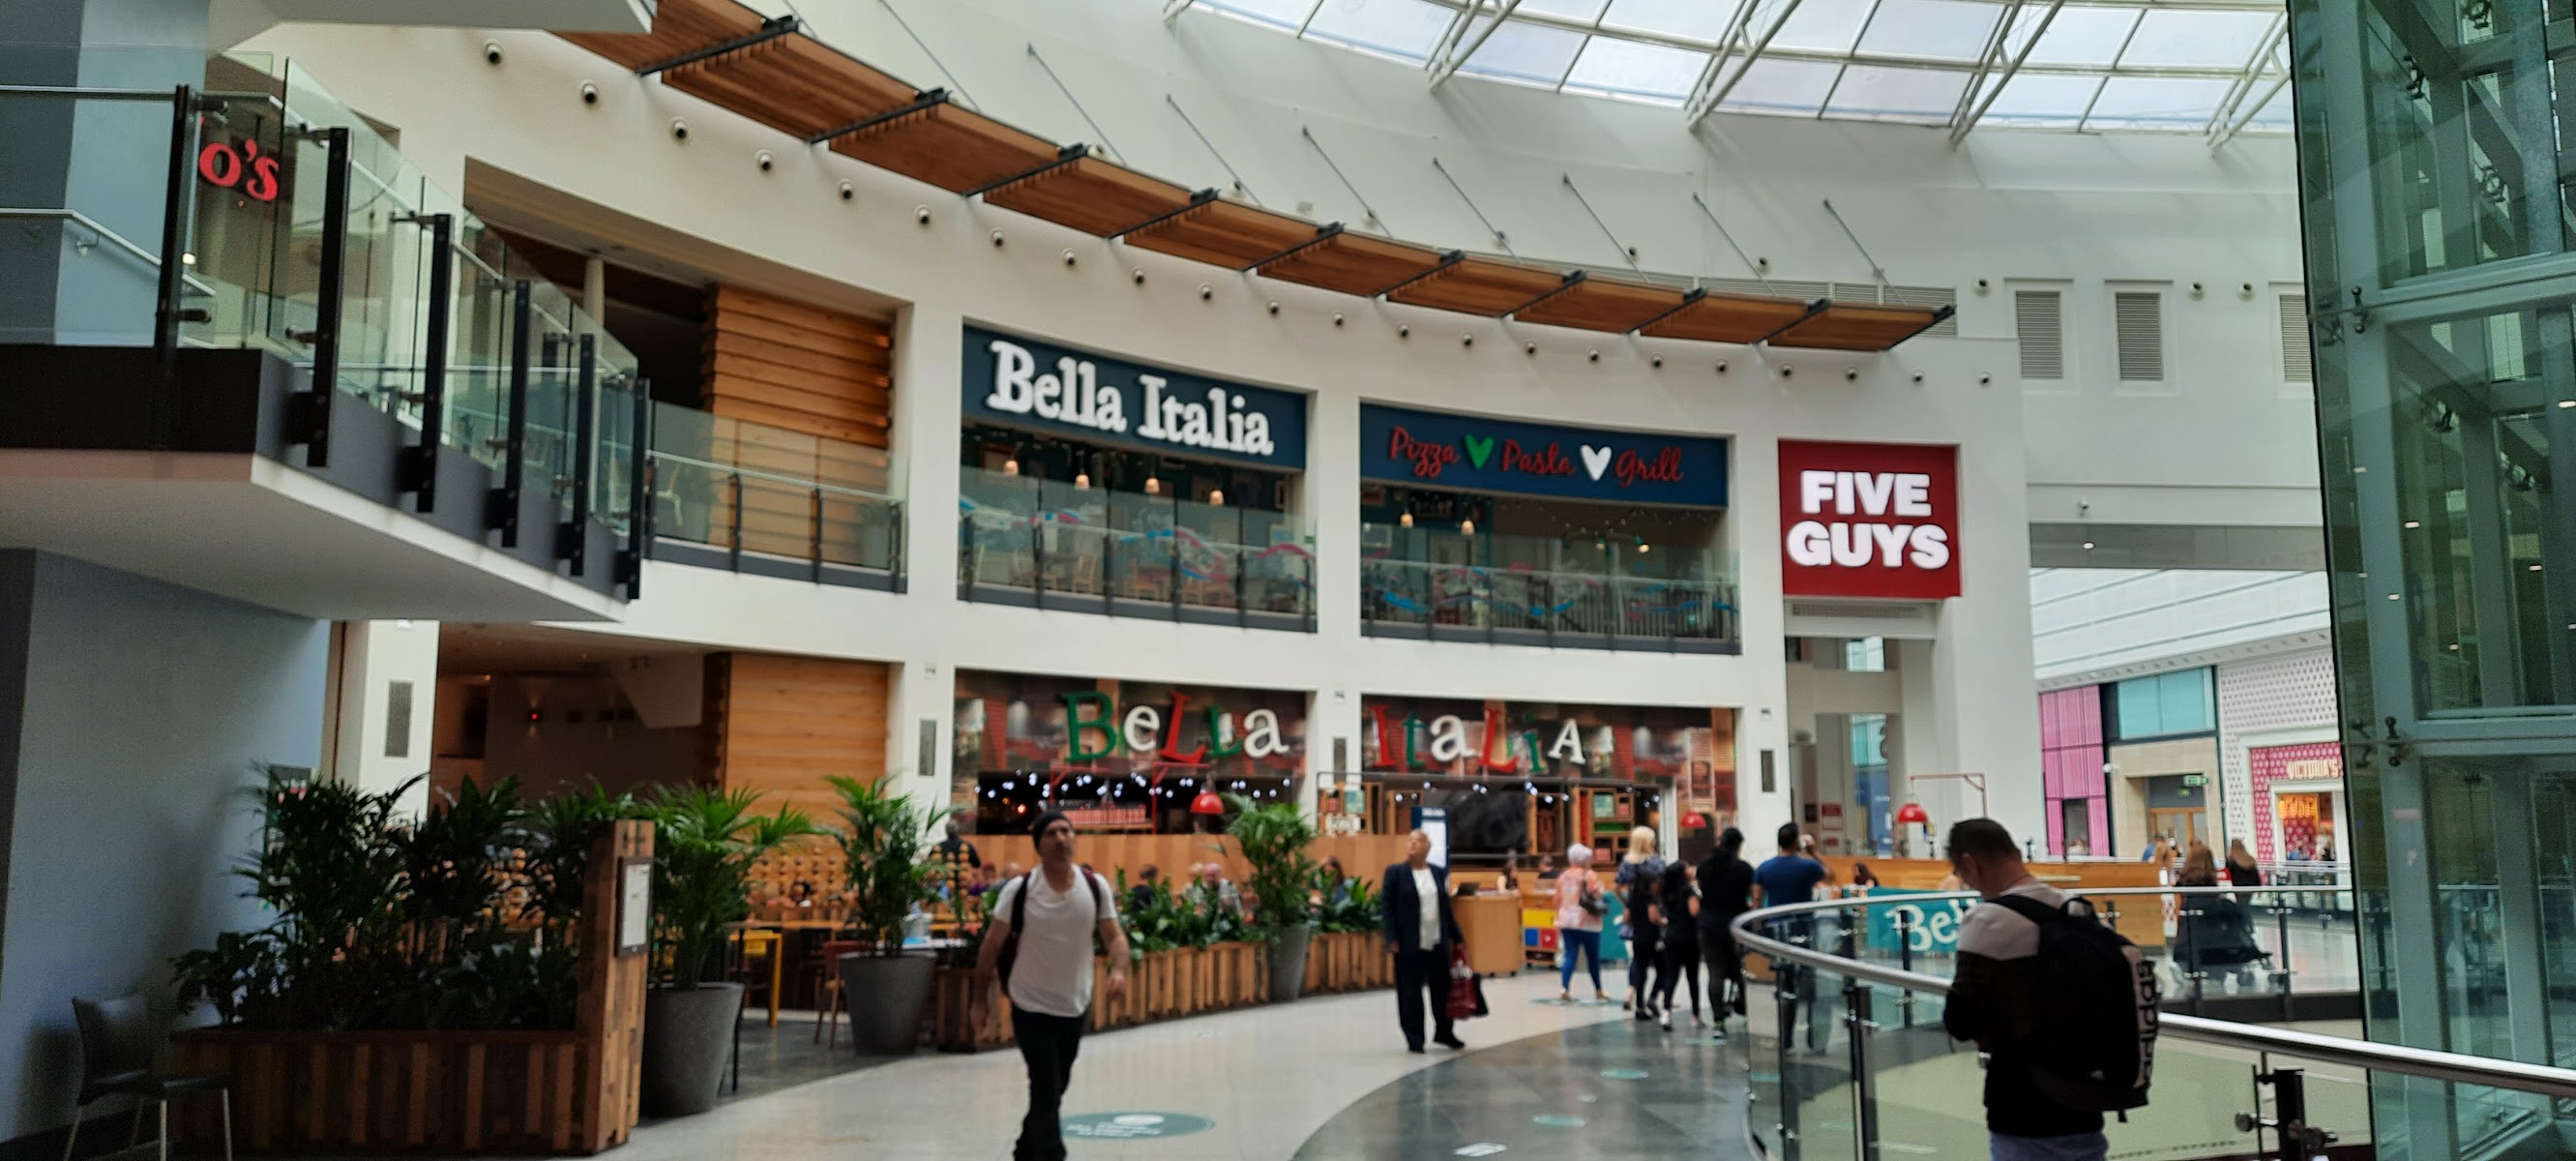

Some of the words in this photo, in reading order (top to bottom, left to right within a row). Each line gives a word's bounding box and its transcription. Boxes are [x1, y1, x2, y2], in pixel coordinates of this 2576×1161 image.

[987, 340, 1127, 432] Bella
[1137, 373, 1275, 456] Italia
[1390, 426, 1461, 478] Pizza
[1502, 439, 1578, 475] Pasta
[1615, 446, 1684, 488] Grill
[1801, 470, 1932, 516] FIVE
[1787, 521, 1949, 569] GUYS
